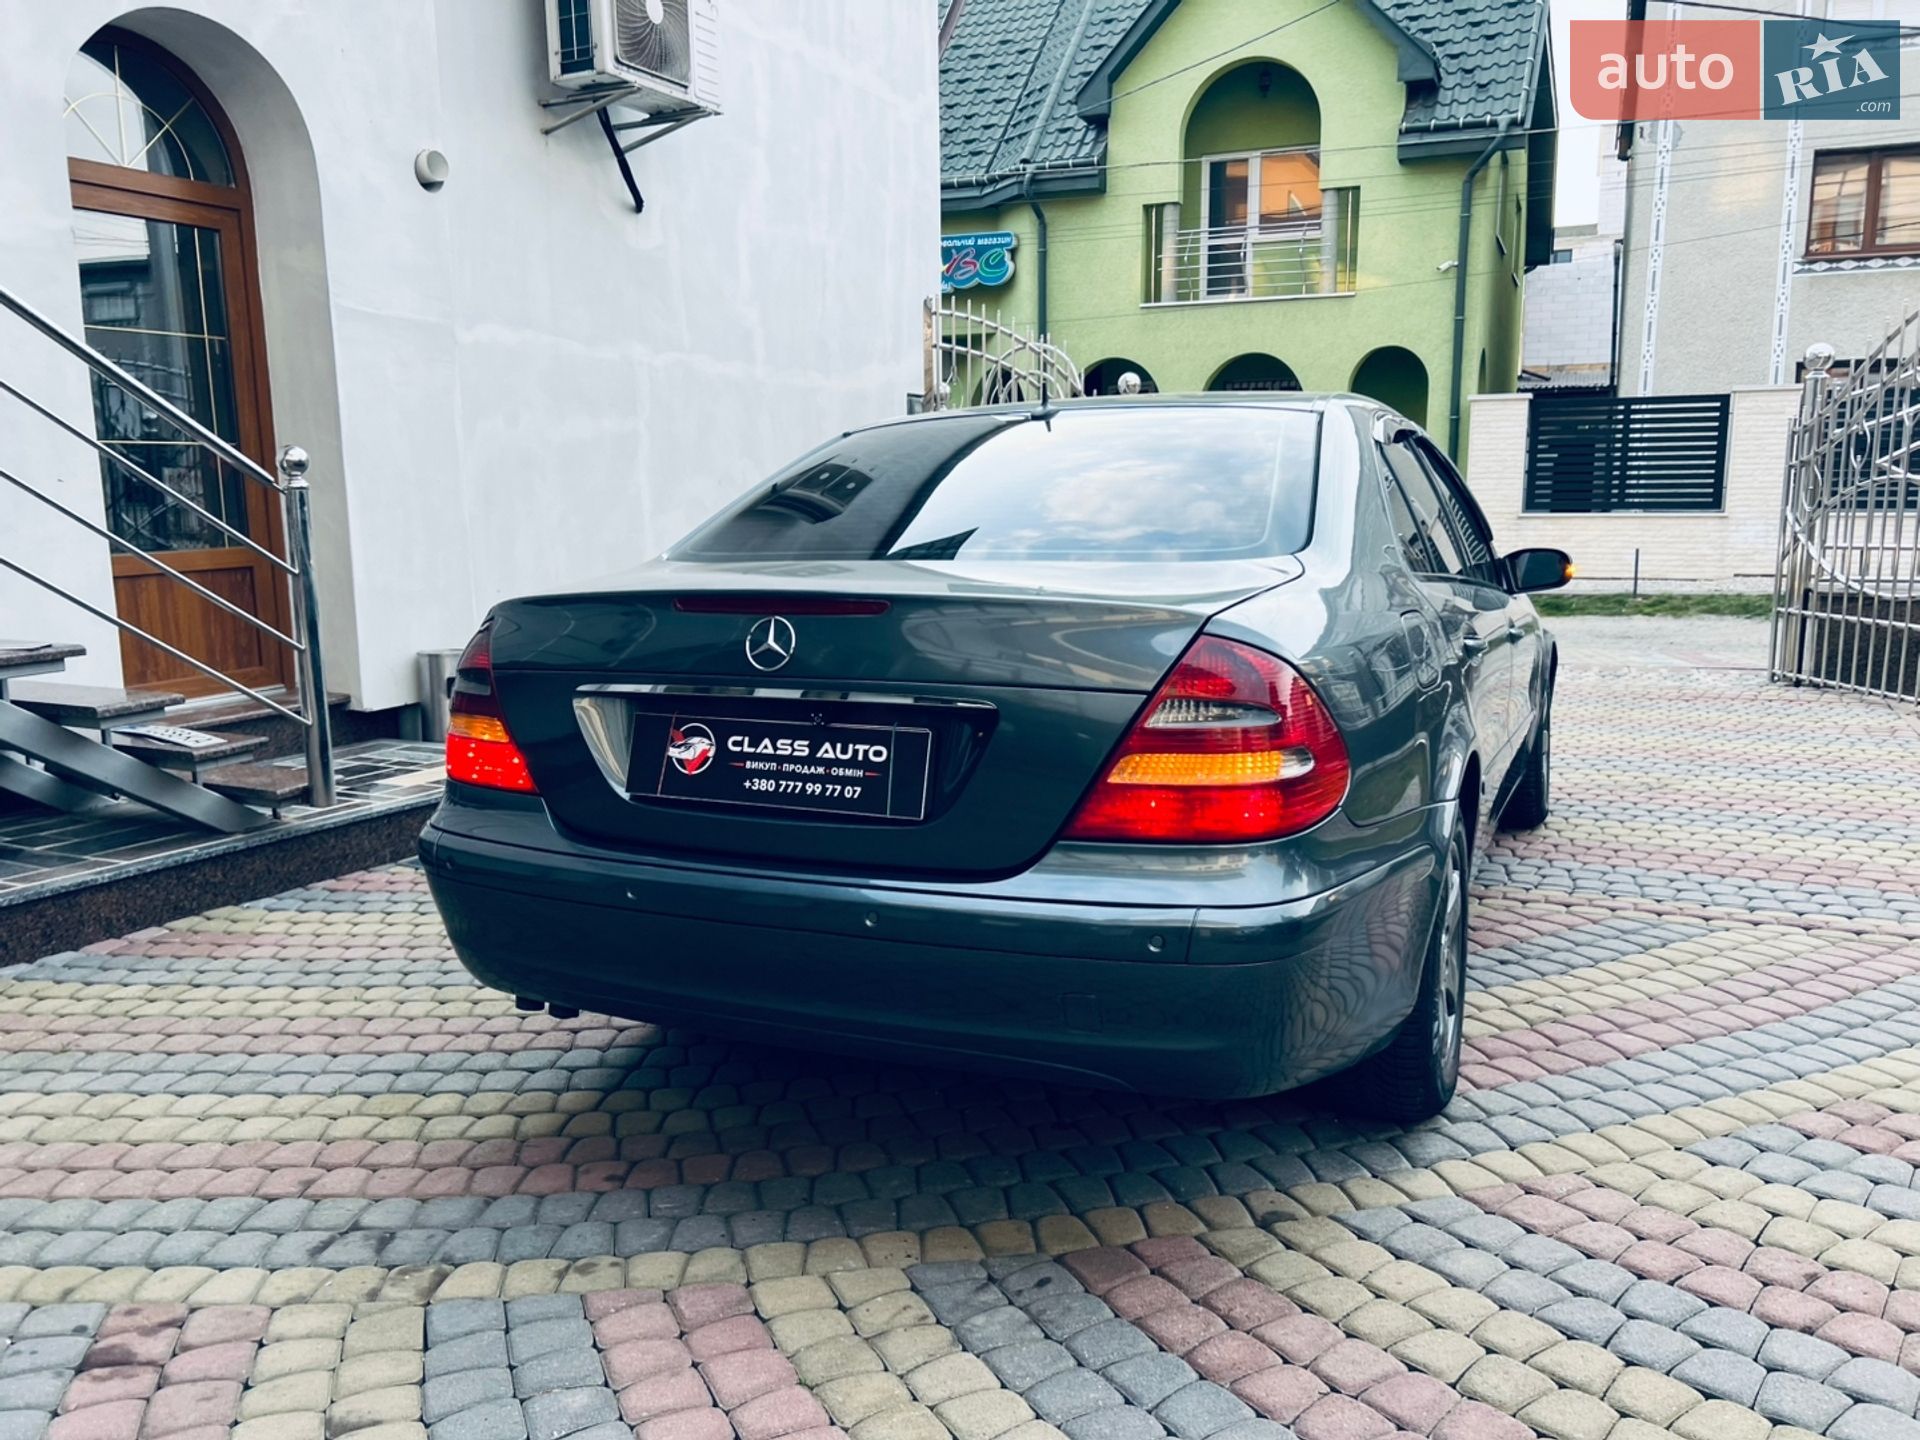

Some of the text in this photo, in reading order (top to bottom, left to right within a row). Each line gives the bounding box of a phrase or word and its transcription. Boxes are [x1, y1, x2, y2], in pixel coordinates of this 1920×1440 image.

[727, 736, 888, 762] CLASS AUTO
[745, 761, 777, 771] ВИКУП
[783, 763, 826, 775] ПРОДАЖ
[743, 778, 862, 799] +380 777 99 77 07
